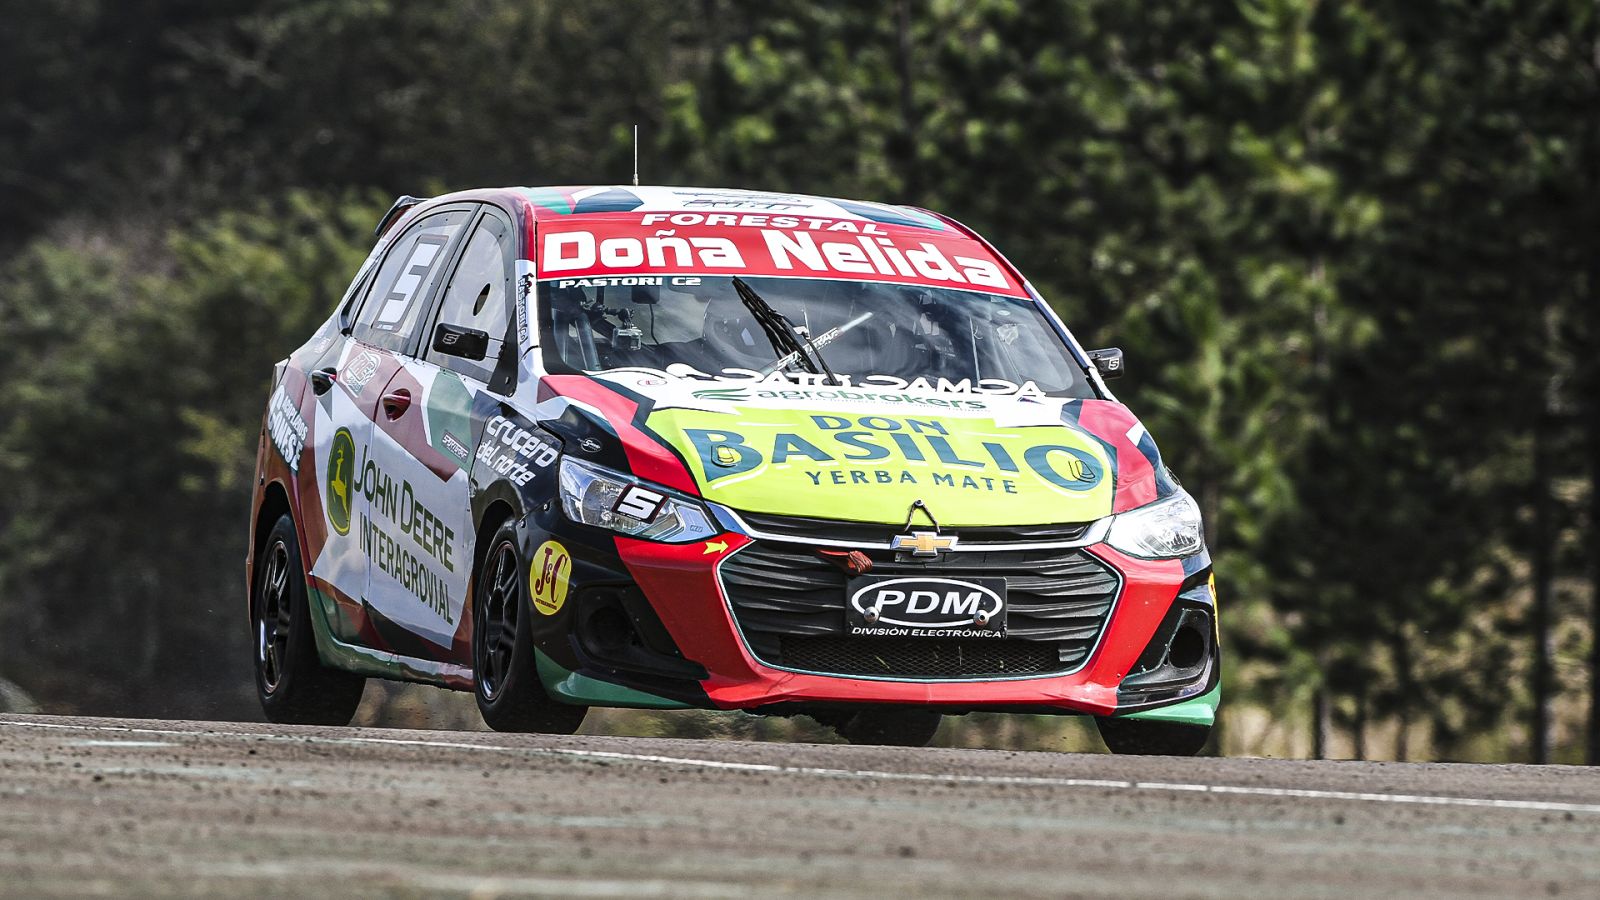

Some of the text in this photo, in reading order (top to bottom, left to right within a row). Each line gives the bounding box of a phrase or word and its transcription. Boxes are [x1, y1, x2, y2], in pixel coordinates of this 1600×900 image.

[641, 213, 888, 236] FORESTAL
[542, 229, 1011, 290] Doña Nelida
[377, 242, 441, 324] 5
[559, 276, 702, 289] PASTORI C2
[756, 390, 987, 410] agrobrokers
[808, 415, 950, 436] DON
[475, 439, 500, 466] del
[491, 454, 537, 487] norte
[683, 428, 1104, 492] BASILIO
[804, 470, 1018, 495] YERBA MATE
[353, 444, 455, 573] JOHN DEERE
[617, 486, 664, 519] 5
[359, 511, 454, 626] INTERAGROVIAL
[874, 590, 983, 615] PDM
[851, 626, 1002, 639] DIVISIÓN ELECTRÓNICA
